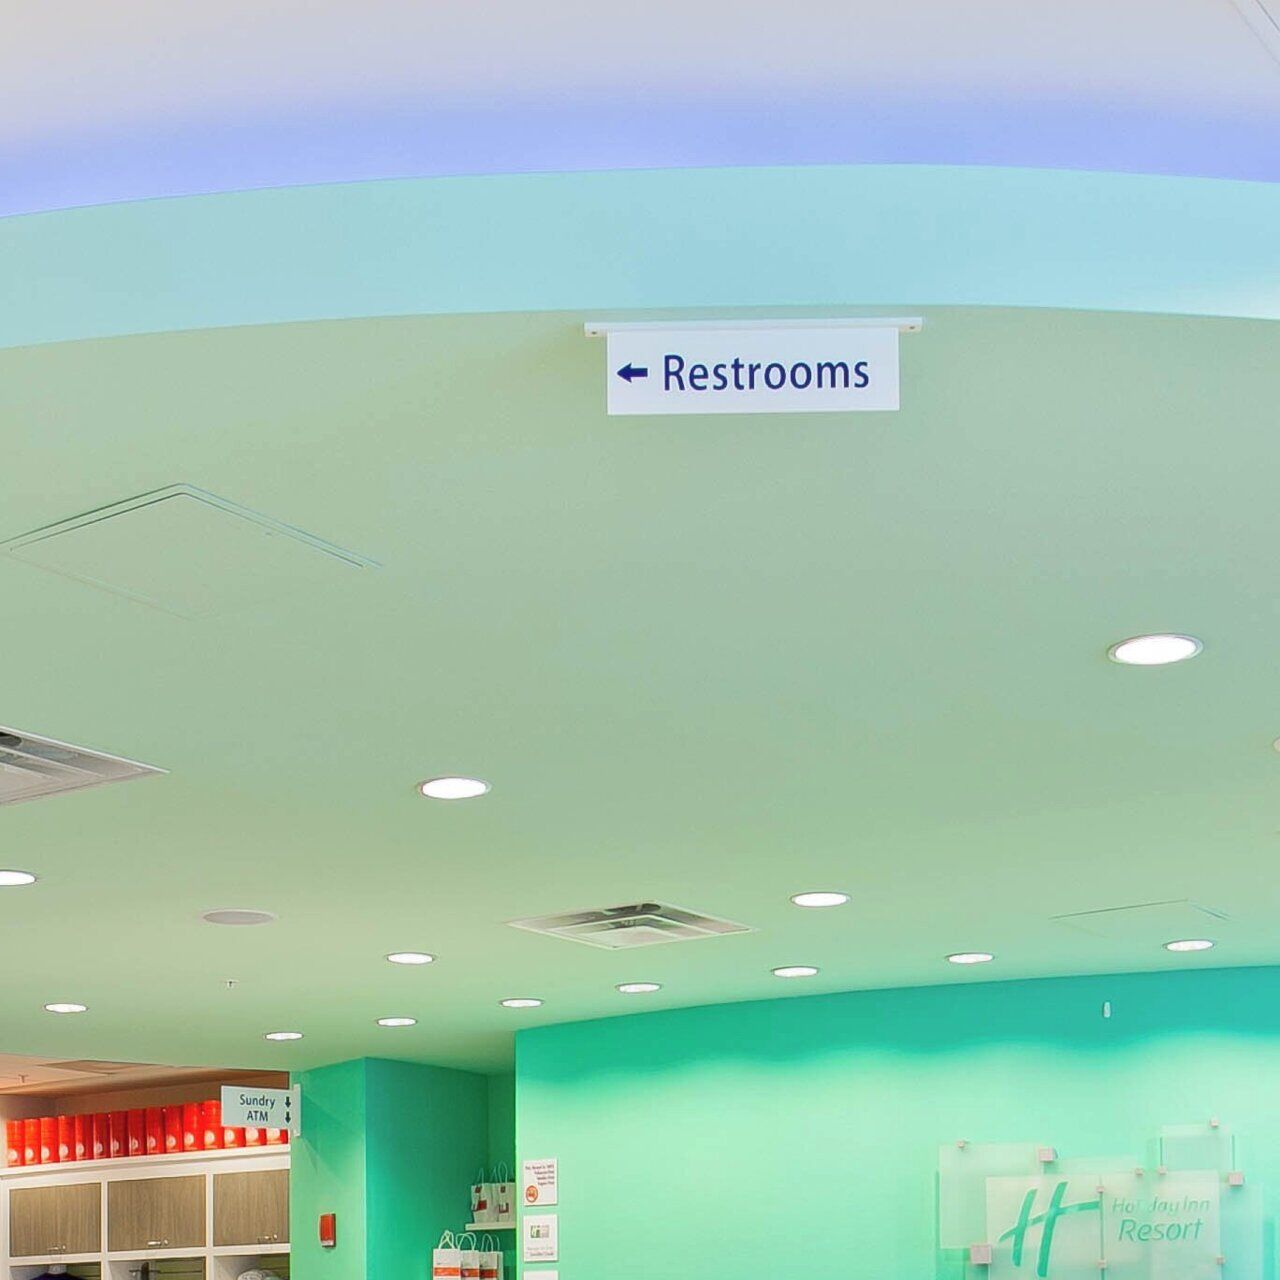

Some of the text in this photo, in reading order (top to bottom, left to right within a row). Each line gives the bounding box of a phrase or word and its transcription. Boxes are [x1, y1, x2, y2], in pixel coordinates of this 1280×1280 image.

[663, 353, 870, 392] Restrooms
[239, 1093, 276, 1110] Sundry
[246, 1110, 269, 1122] ATM
[1118, 1217, 1205, 1242] Resort
